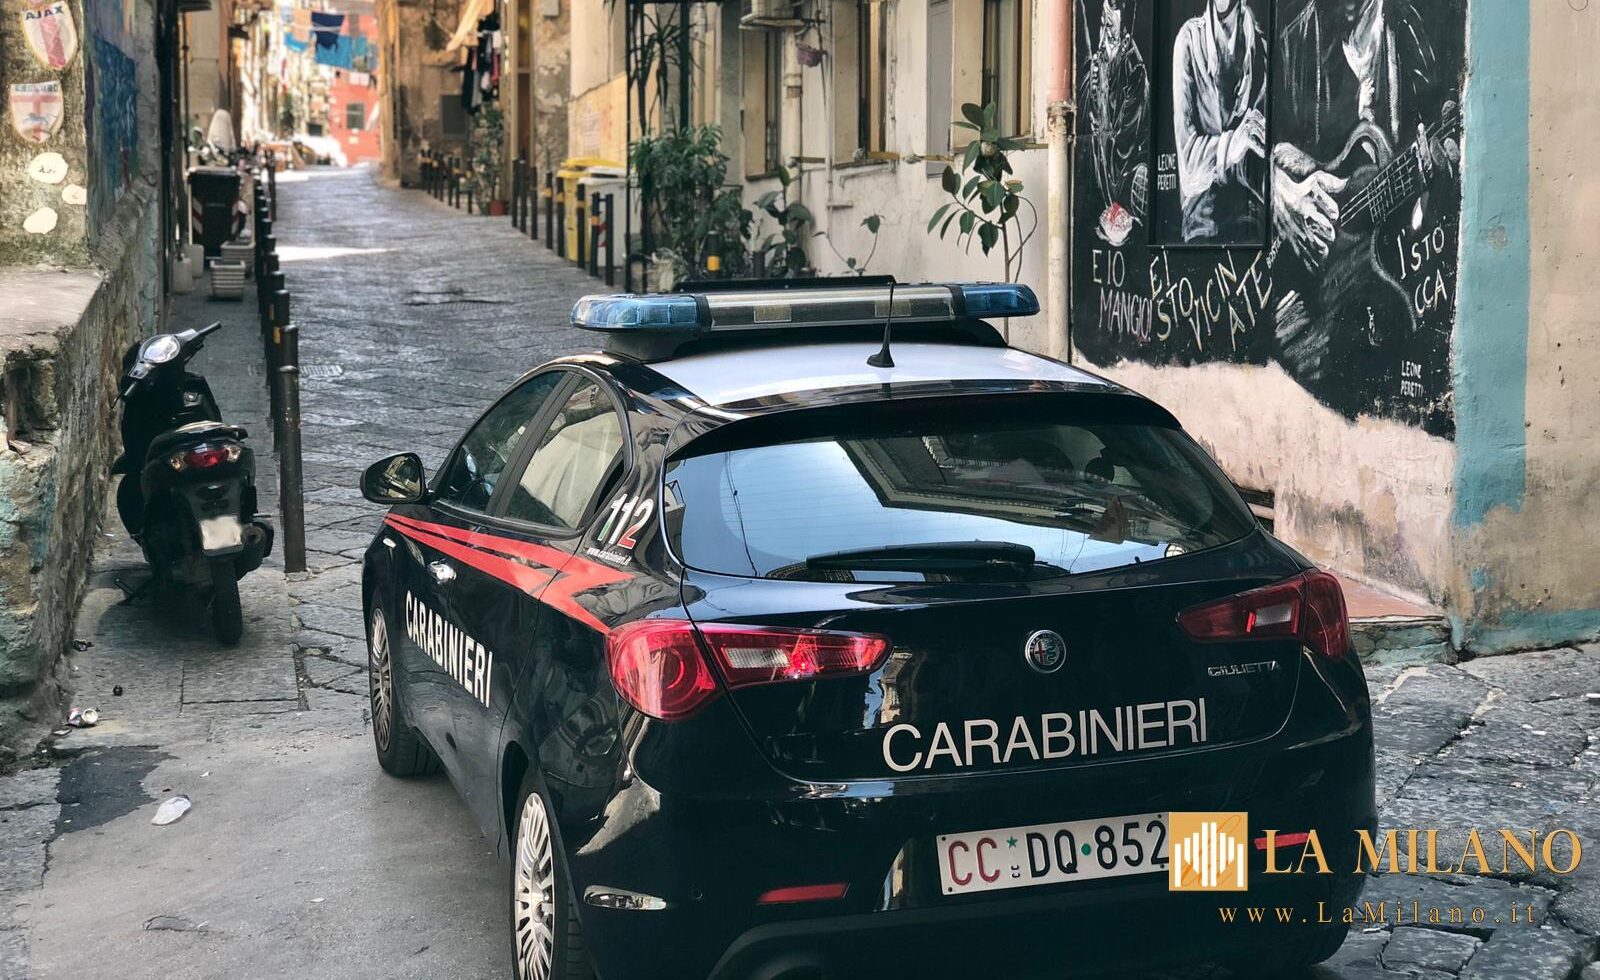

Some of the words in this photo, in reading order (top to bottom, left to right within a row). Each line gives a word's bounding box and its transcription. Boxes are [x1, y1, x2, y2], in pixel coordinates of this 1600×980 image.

[25, 6, 65, 21] AJAX
[1157, 153, 1177, 171] LEONE
[1401, 360, 1423, 379] LEONE
[597, 493, 654, 550] 112
[405, 589, 493, 708] CARABINIERI
[882, 697, 1207, 773] CARABINIERI
[948, 837, 1001, 886] CC
